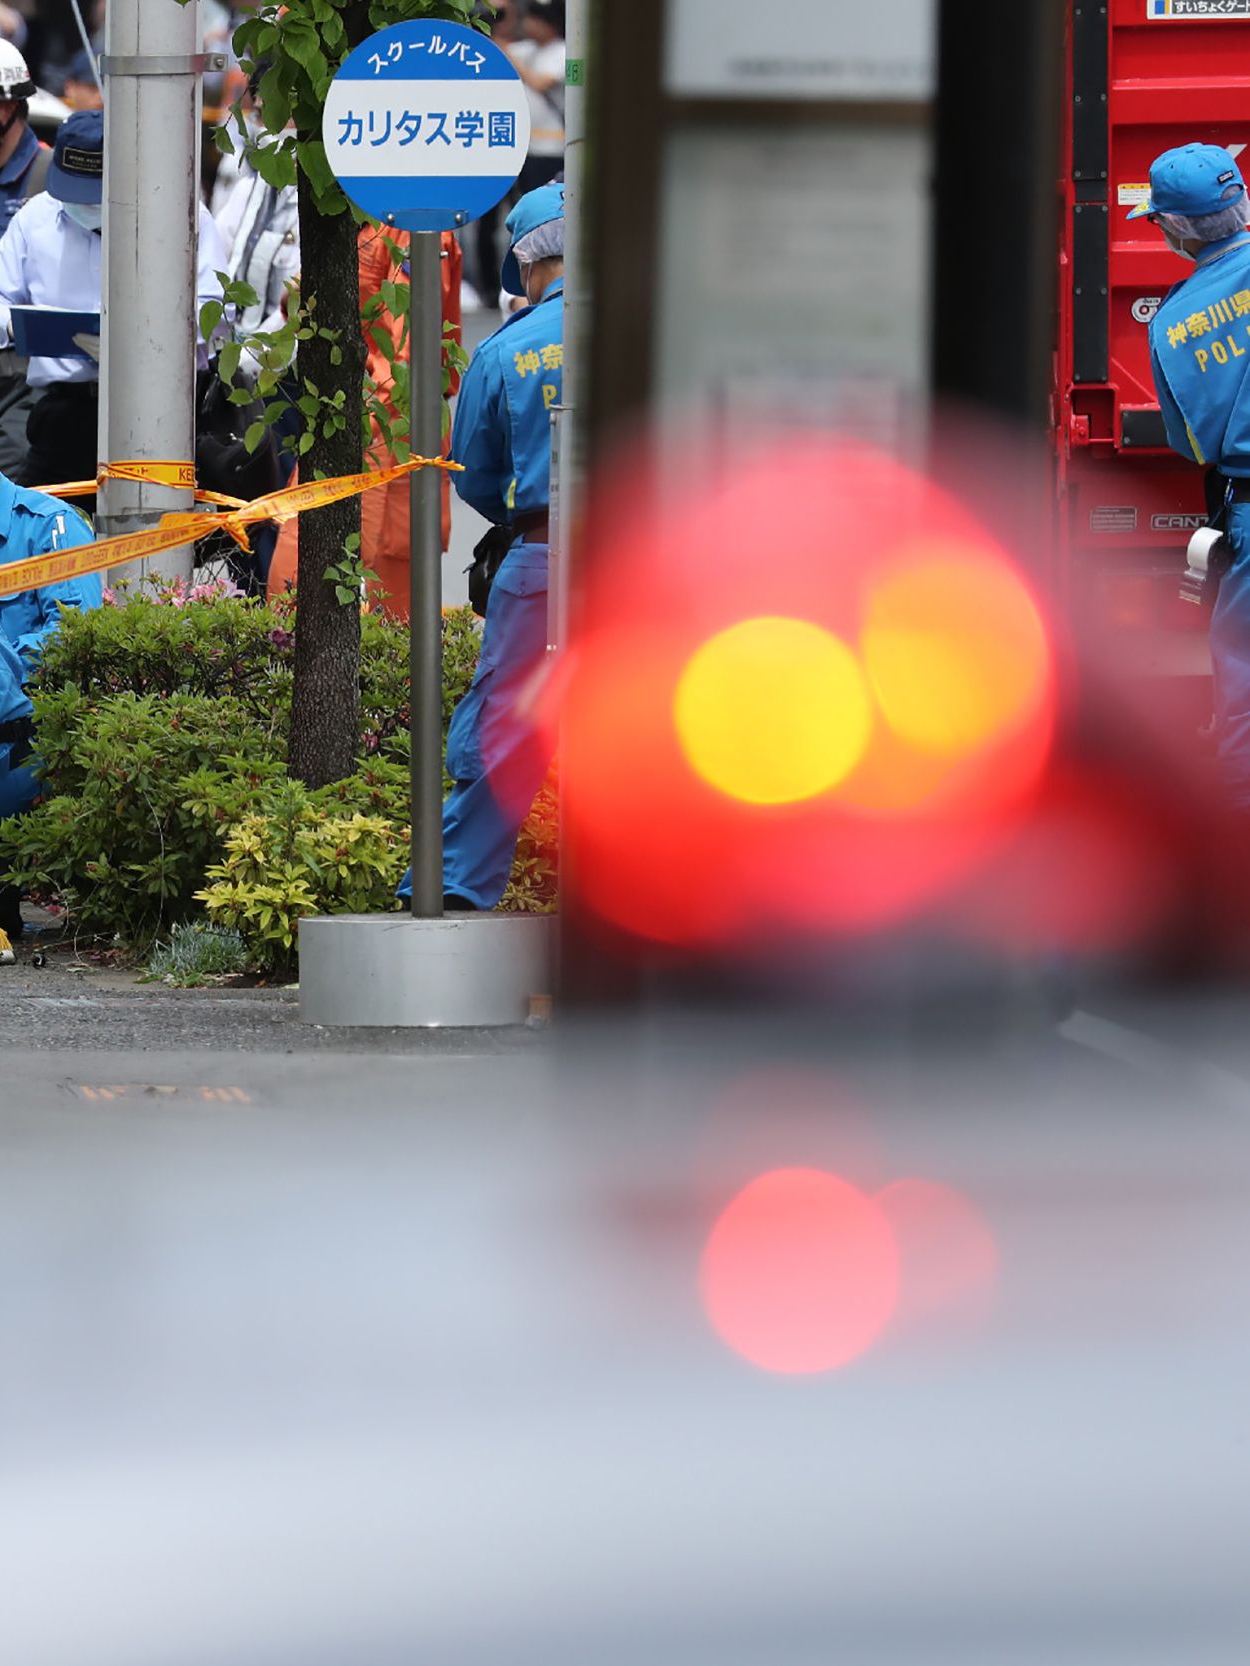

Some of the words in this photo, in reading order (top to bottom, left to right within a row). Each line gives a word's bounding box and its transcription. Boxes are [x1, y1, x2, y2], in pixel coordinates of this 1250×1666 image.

[367, 35, 487, 75] スクールバス
[338, 110, 516, 148] カリタス学園
[1194, 325, 1250, 373] POL
